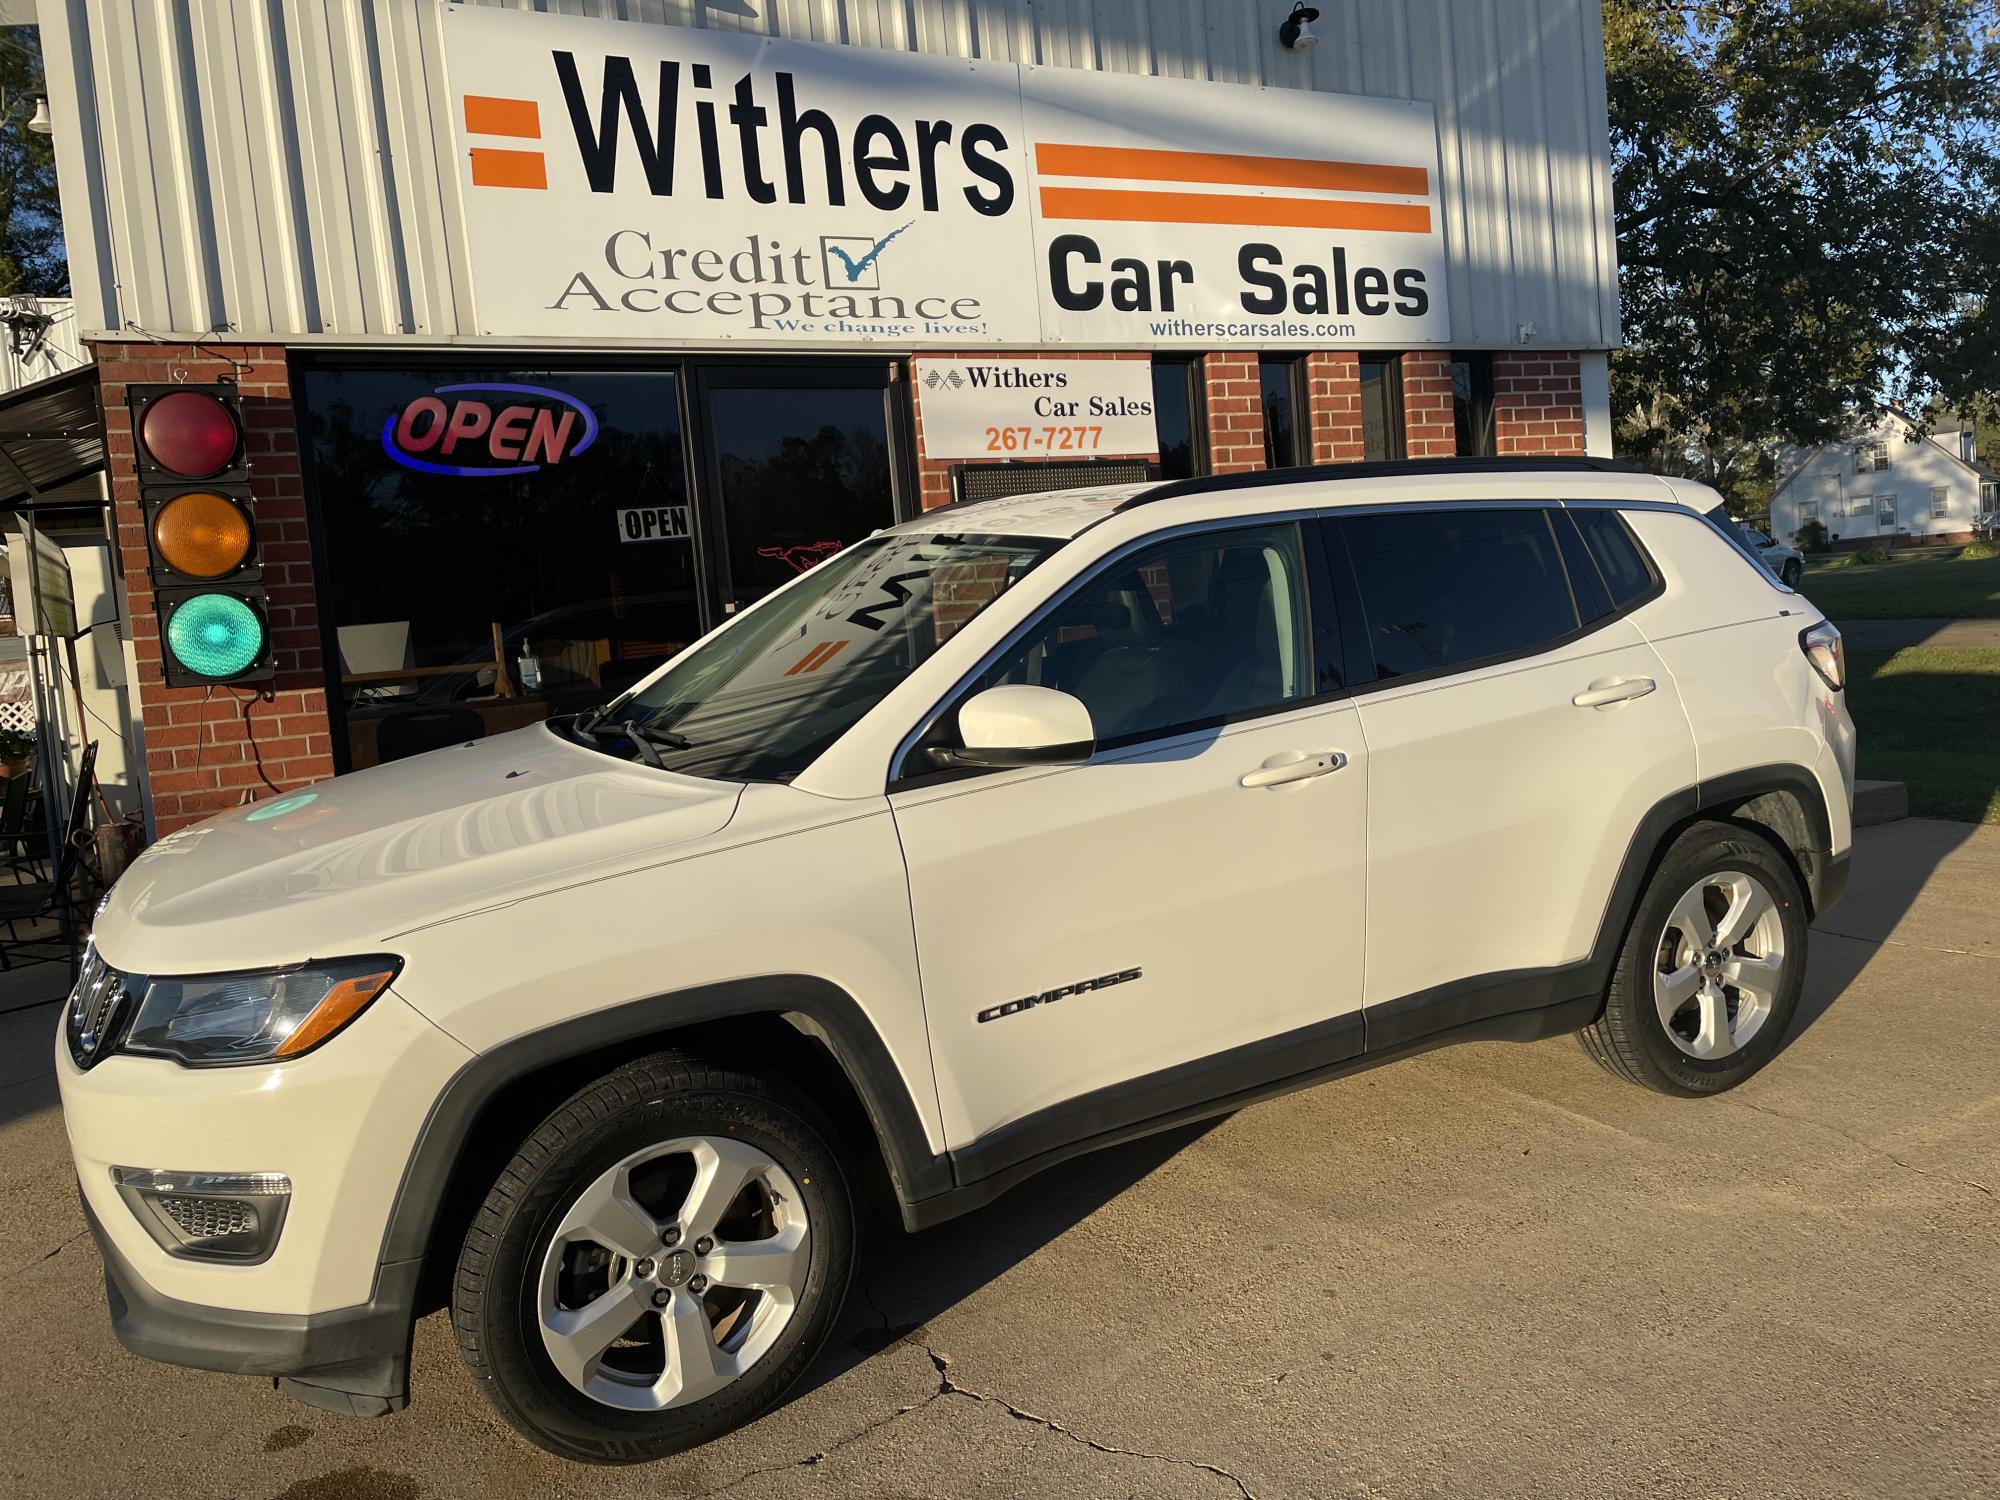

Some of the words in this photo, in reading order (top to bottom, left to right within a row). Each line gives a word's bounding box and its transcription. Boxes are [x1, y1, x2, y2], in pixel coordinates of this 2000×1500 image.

[551, 50, 1015, 217] Withers
[604, 229, 815, 287] Credit
[1048, 234, 1195, 312] Car
[1237, 242, 1429, 317] Sales
[544, 272, 982, 330] Acceptance
[774, 319, 815, 332] We
[824, 320, 915, 337] change
[925, 322, 988, 335] lives!
[1150, 319, 1356, 337] witherscarsales.com
[966, 366, 1068, 389] Withers
[1034, 396, 1079, 418] Car
[1089, 395, 1153, 417] Sales
[398, 397, 576, 464] OPEN
[985, 426, 1104, 452] 267-7277
[625, 507, 688, 540] OPEN
[977, 966, 1143, 1023] COMPASS
